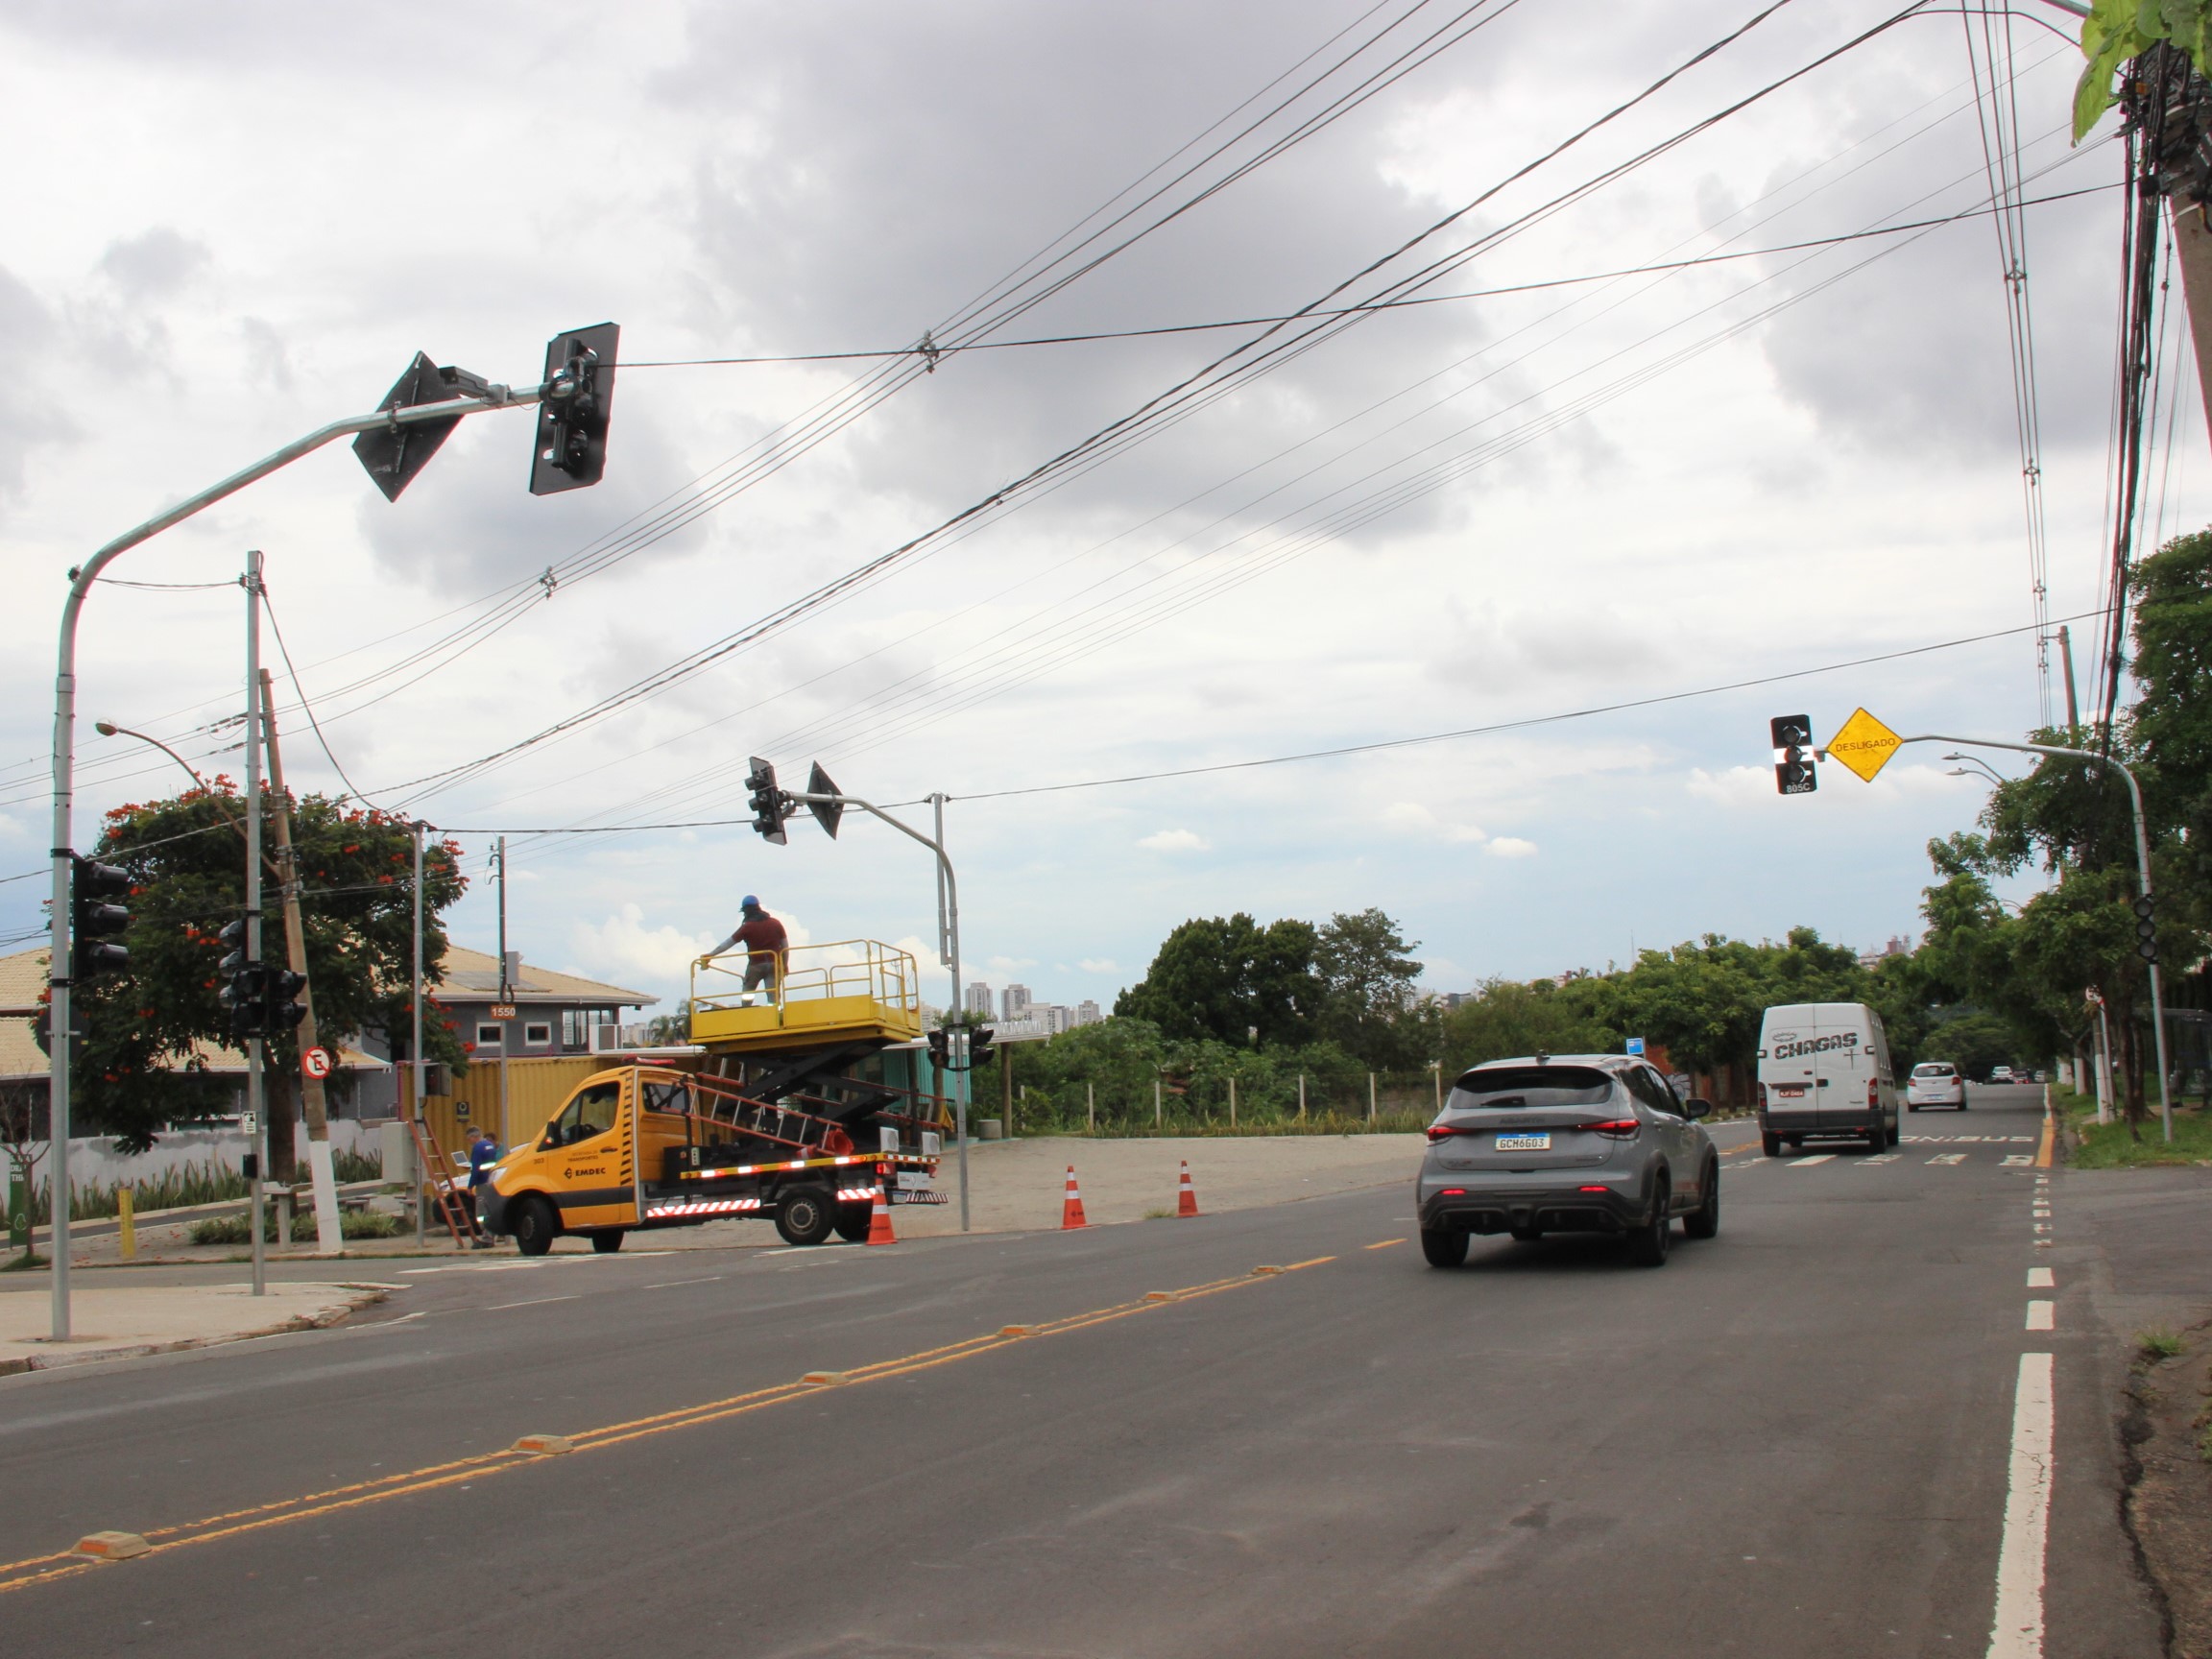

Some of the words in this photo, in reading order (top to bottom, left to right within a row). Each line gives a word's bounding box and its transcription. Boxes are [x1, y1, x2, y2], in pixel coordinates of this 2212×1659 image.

[1835, 738, 1896, 752] DESLIGADO
[1786, 782, 1811, 794] 805C
[492, 1007, 517, 1017] 1550
[1774, 1032, 1857, 1059] CHAGAS
[1500, 1138, 1545, 1149] GCH6G03
[575, 1166, 606, 1176] EMDEC
